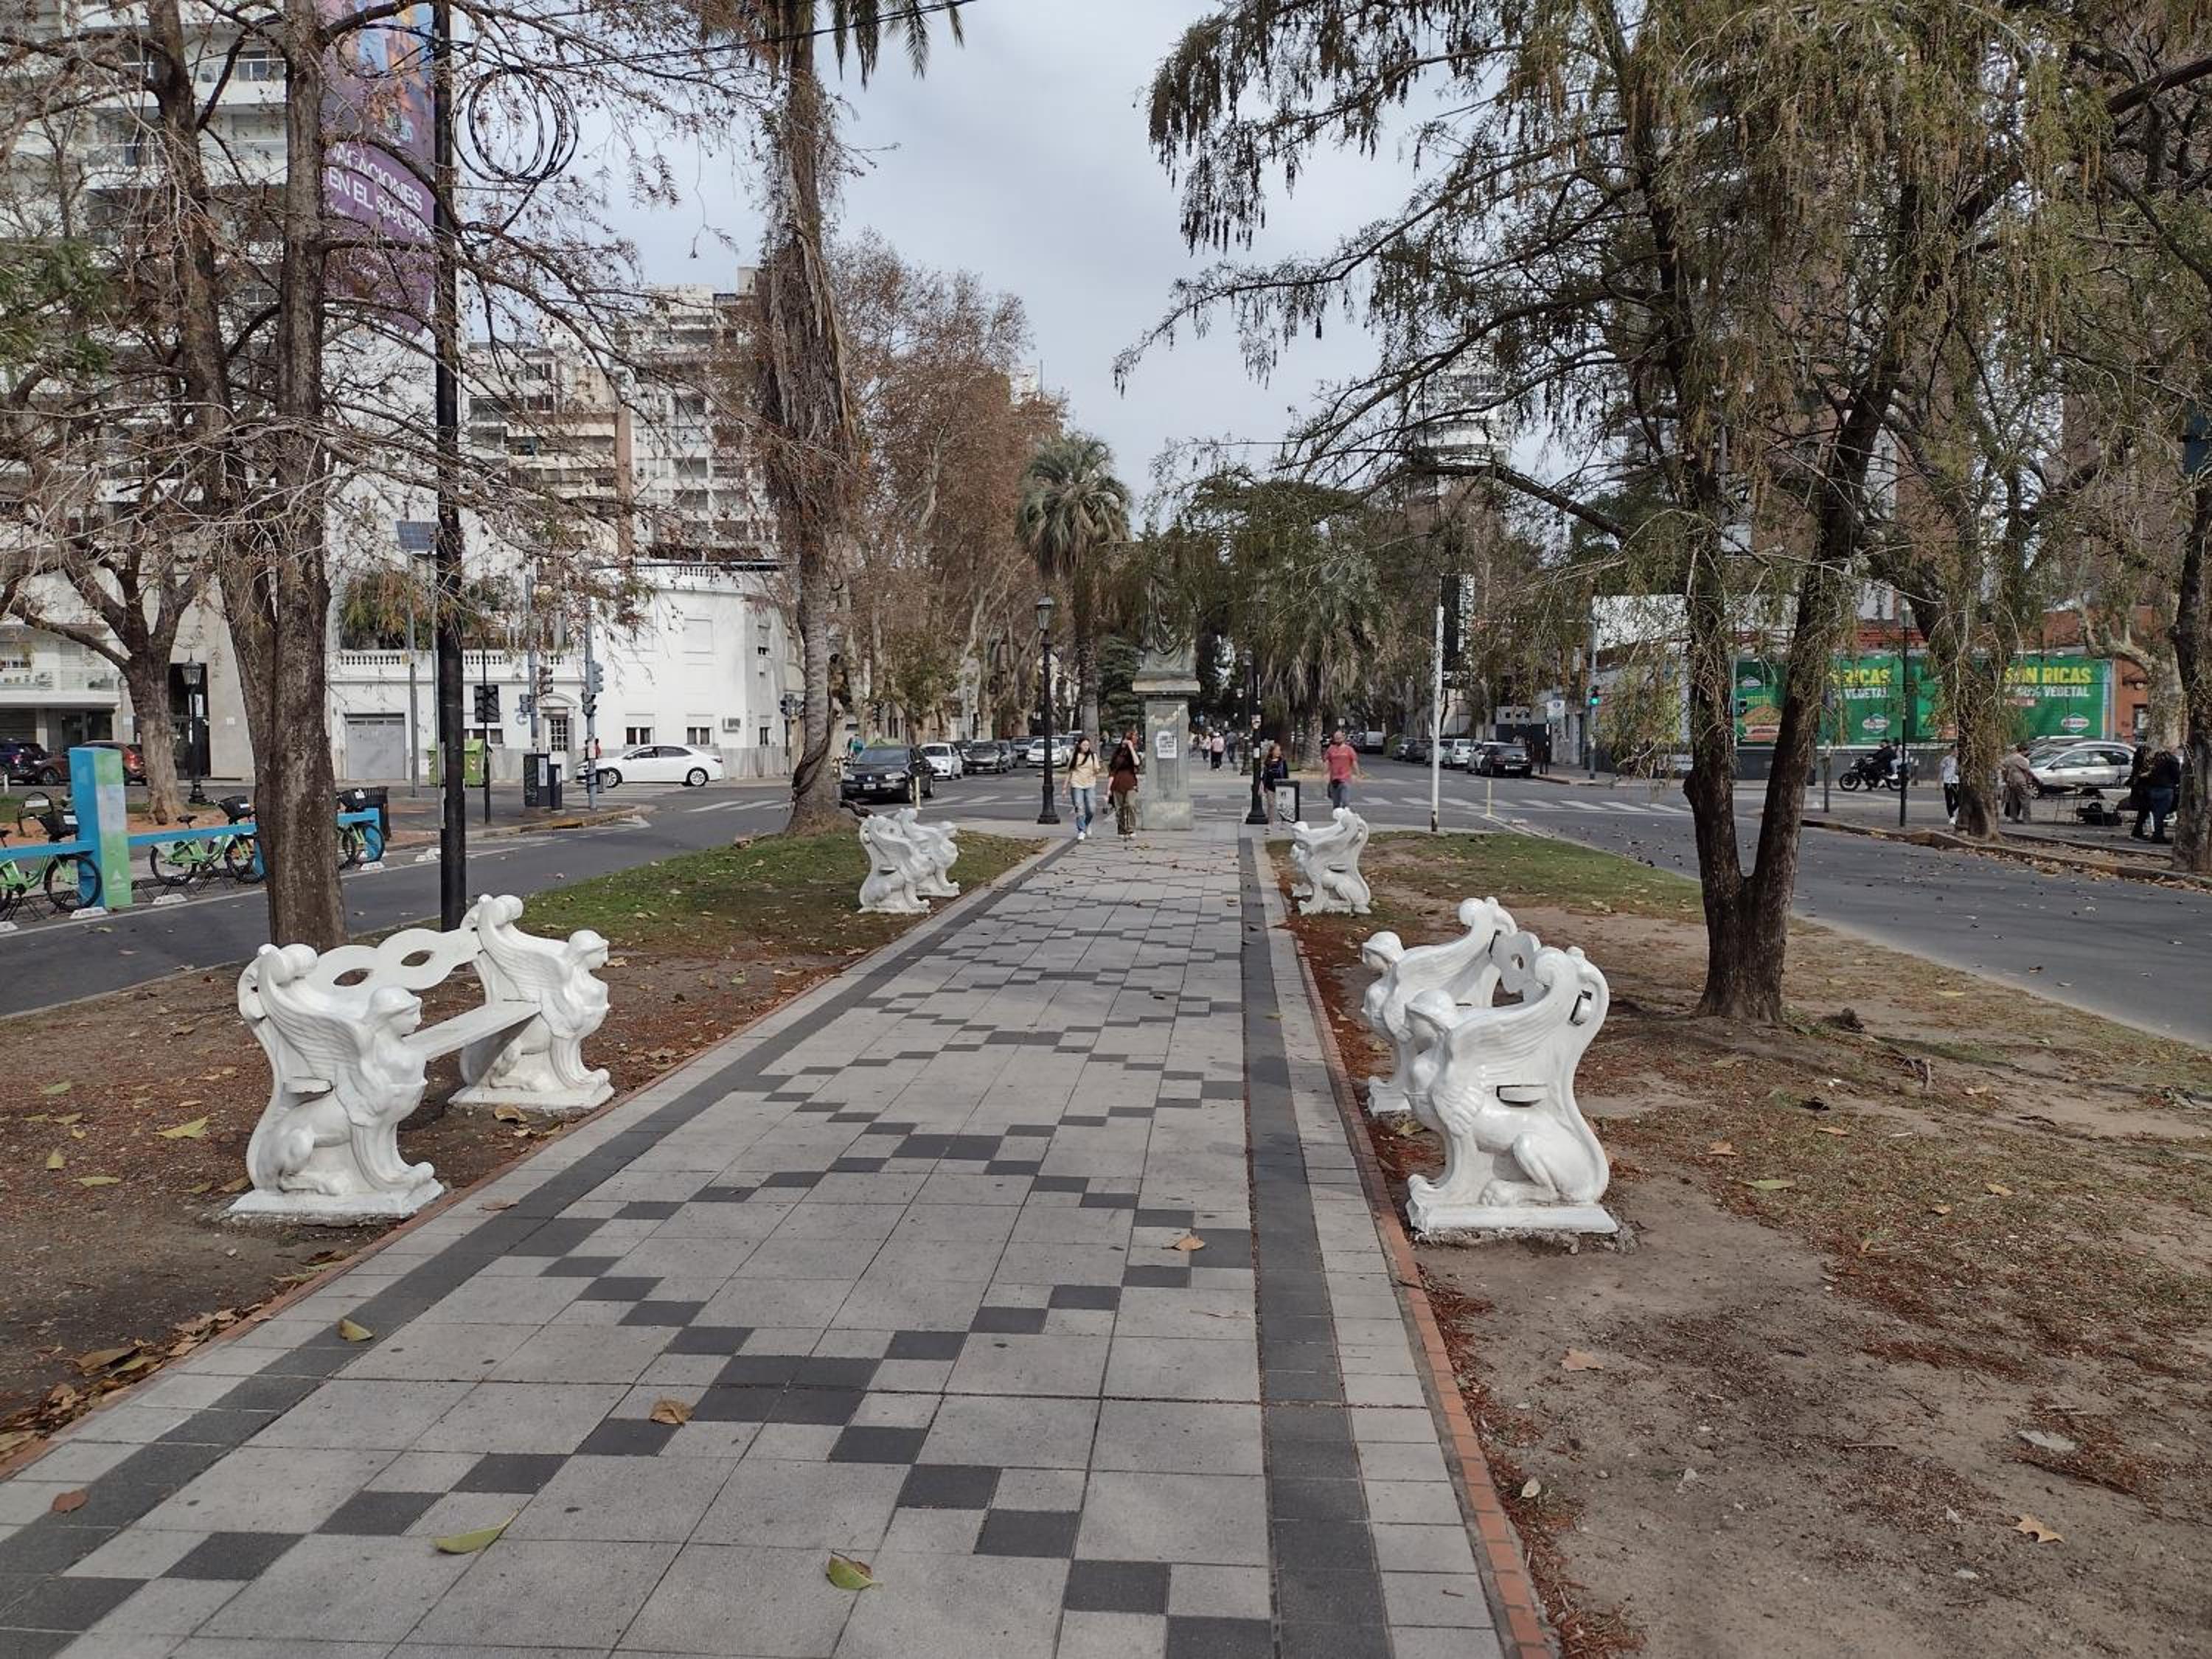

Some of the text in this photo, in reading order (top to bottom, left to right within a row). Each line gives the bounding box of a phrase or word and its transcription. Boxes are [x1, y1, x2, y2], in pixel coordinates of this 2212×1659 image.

[329, 166, 350, 196] EN
[353, 180, 374, 210] EL
[2004, 667, 2091, 684] SN RICAS
[2043, 685, 2090, 697] VEGETAL
